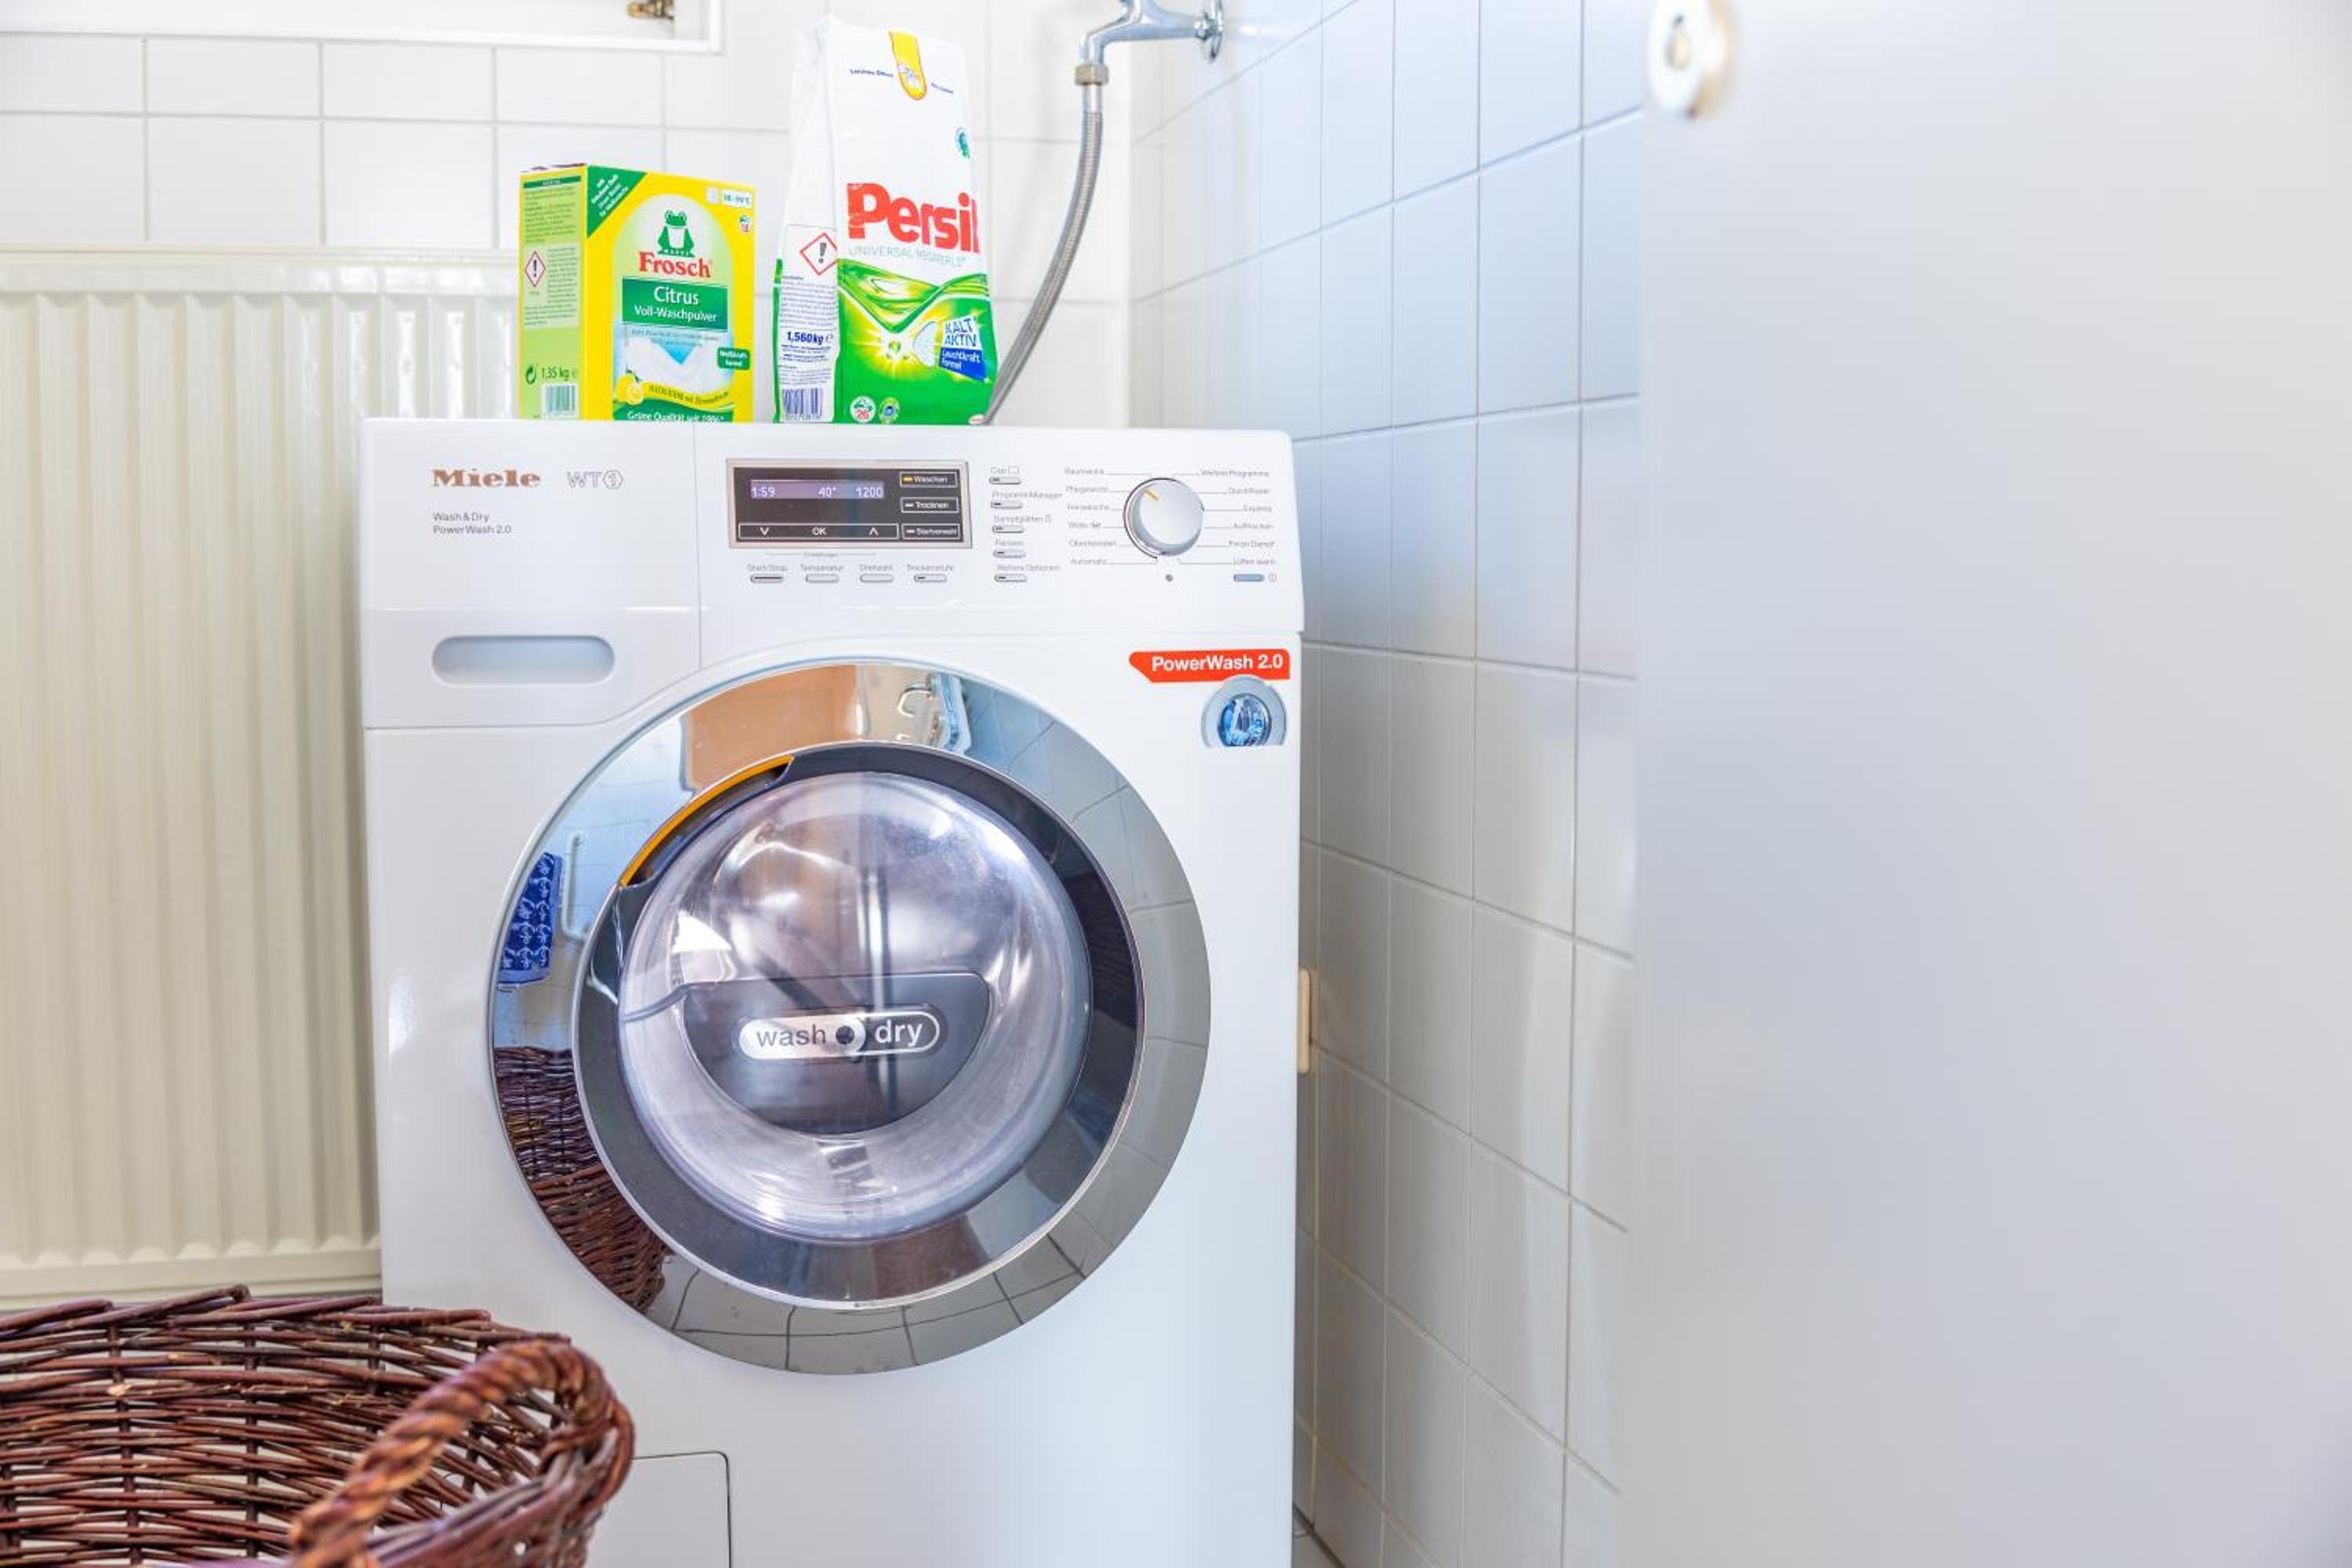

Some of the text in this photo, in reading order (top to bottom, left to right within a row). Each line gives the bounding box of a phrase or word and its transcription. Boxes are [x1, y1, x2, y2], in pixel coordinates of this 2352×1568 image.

[847, 183, 980, 253] Persil
[638, 251, 712, 278] Frosch
[654, 285, 699, 306] Citrus
[633, 303, 717, 323] Voll-Waschpulver
[945, 318, 974, 334] KALT
[944, 333, 977, 347] AKTIV
[433, 468, 541, 488] Miele
[750, 486, 775, 498] 1:59
[855, 486, 884, 498] 1200
[433, 524, 512, 534] PowerWash 2.0
[811, 526, 827, 536] OK
[1151, 653, 1283, 672] PowerWash 2.0
[755, 1019, 924, 1047] wash dry
